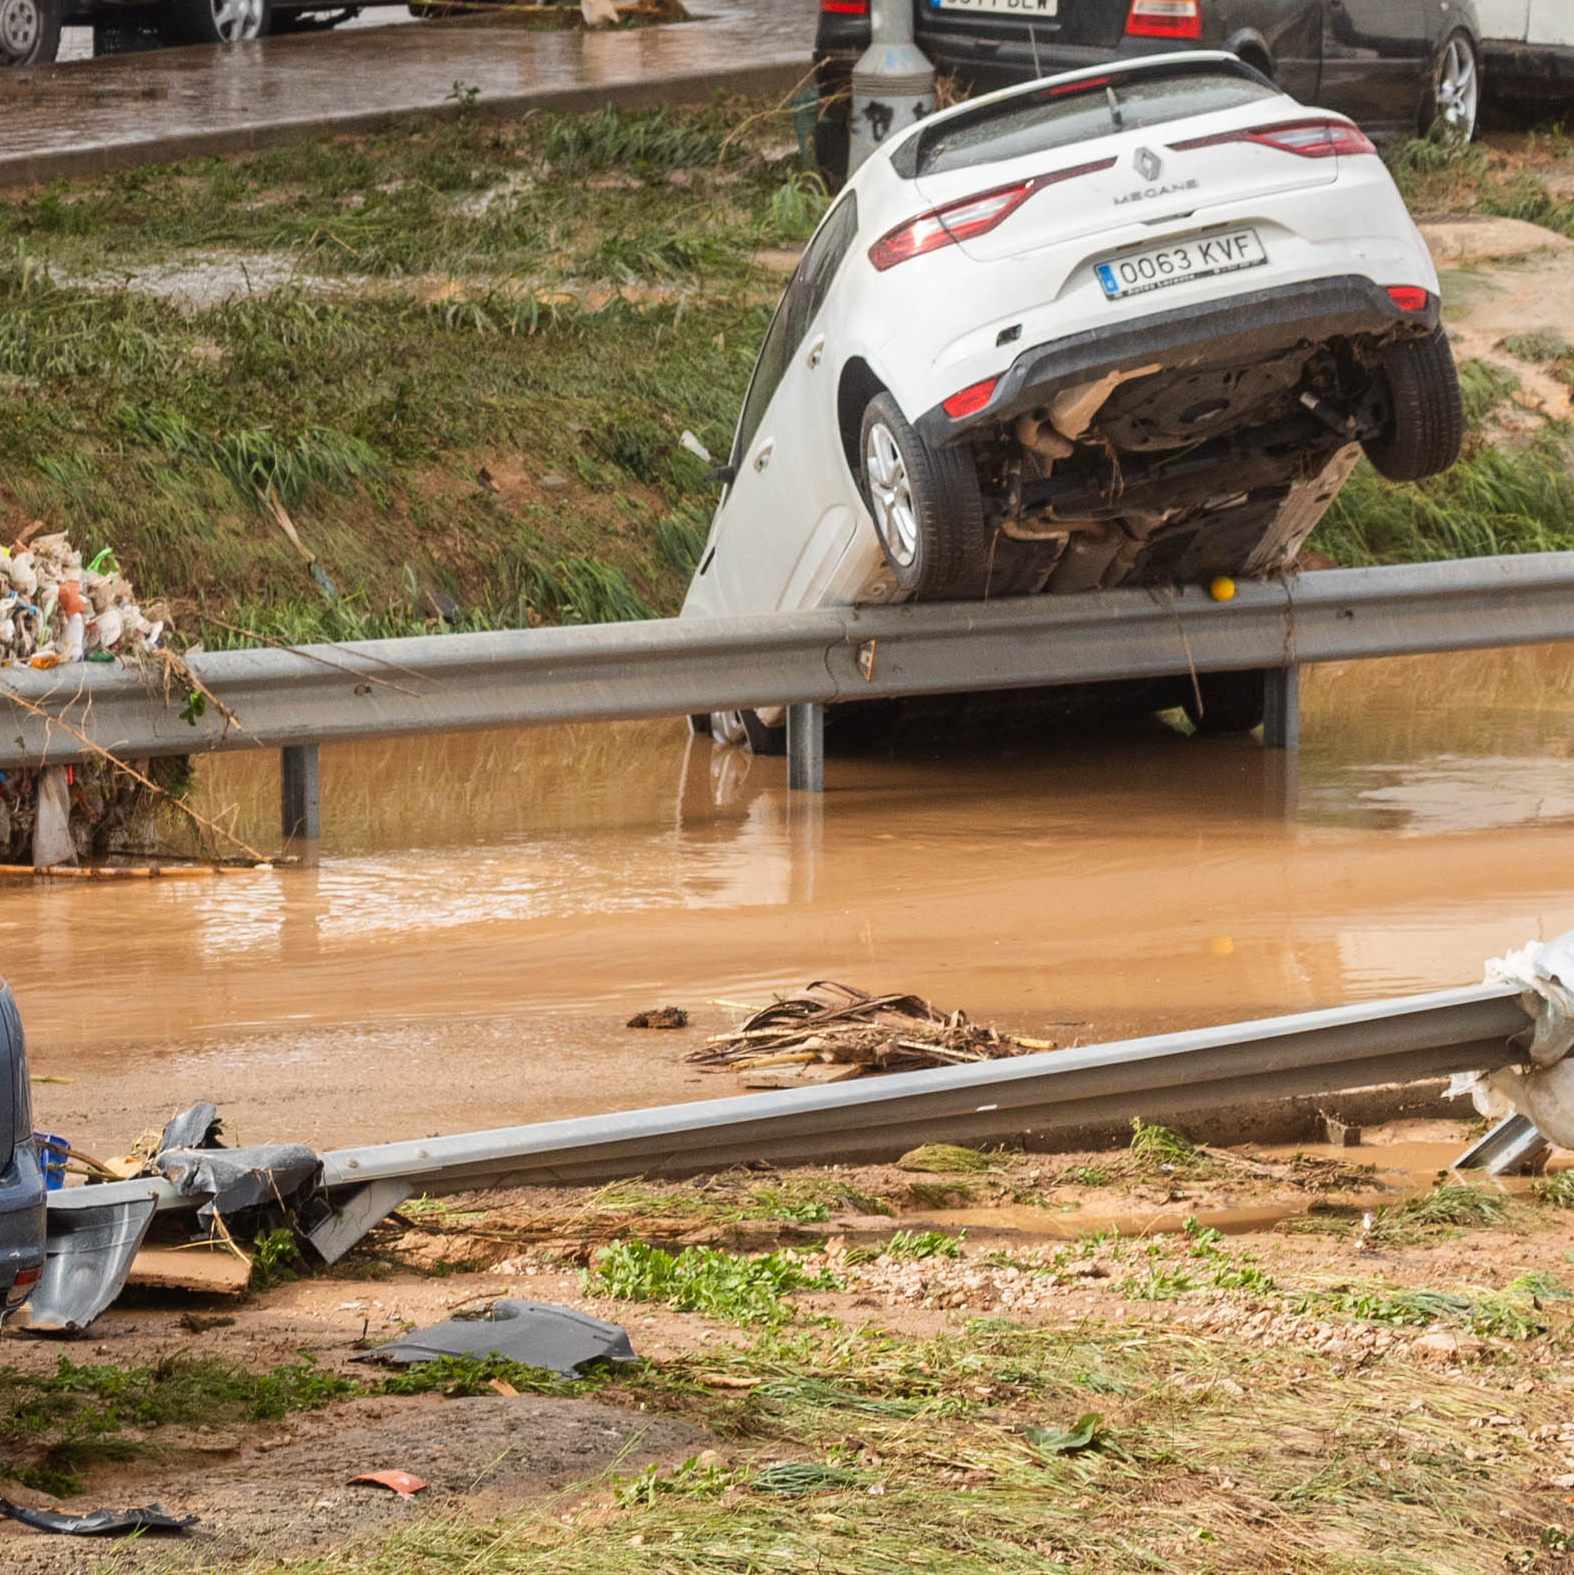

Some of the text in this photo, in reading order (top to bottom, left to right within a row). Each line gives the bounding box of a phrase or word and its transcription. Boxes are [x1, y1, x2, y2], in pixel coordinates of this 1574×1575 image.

[1112, 178, 1200, 206] MEGANE
[1119, 248, 1193, 284] 0063
[1197, 234, 1250, 266] KVF
